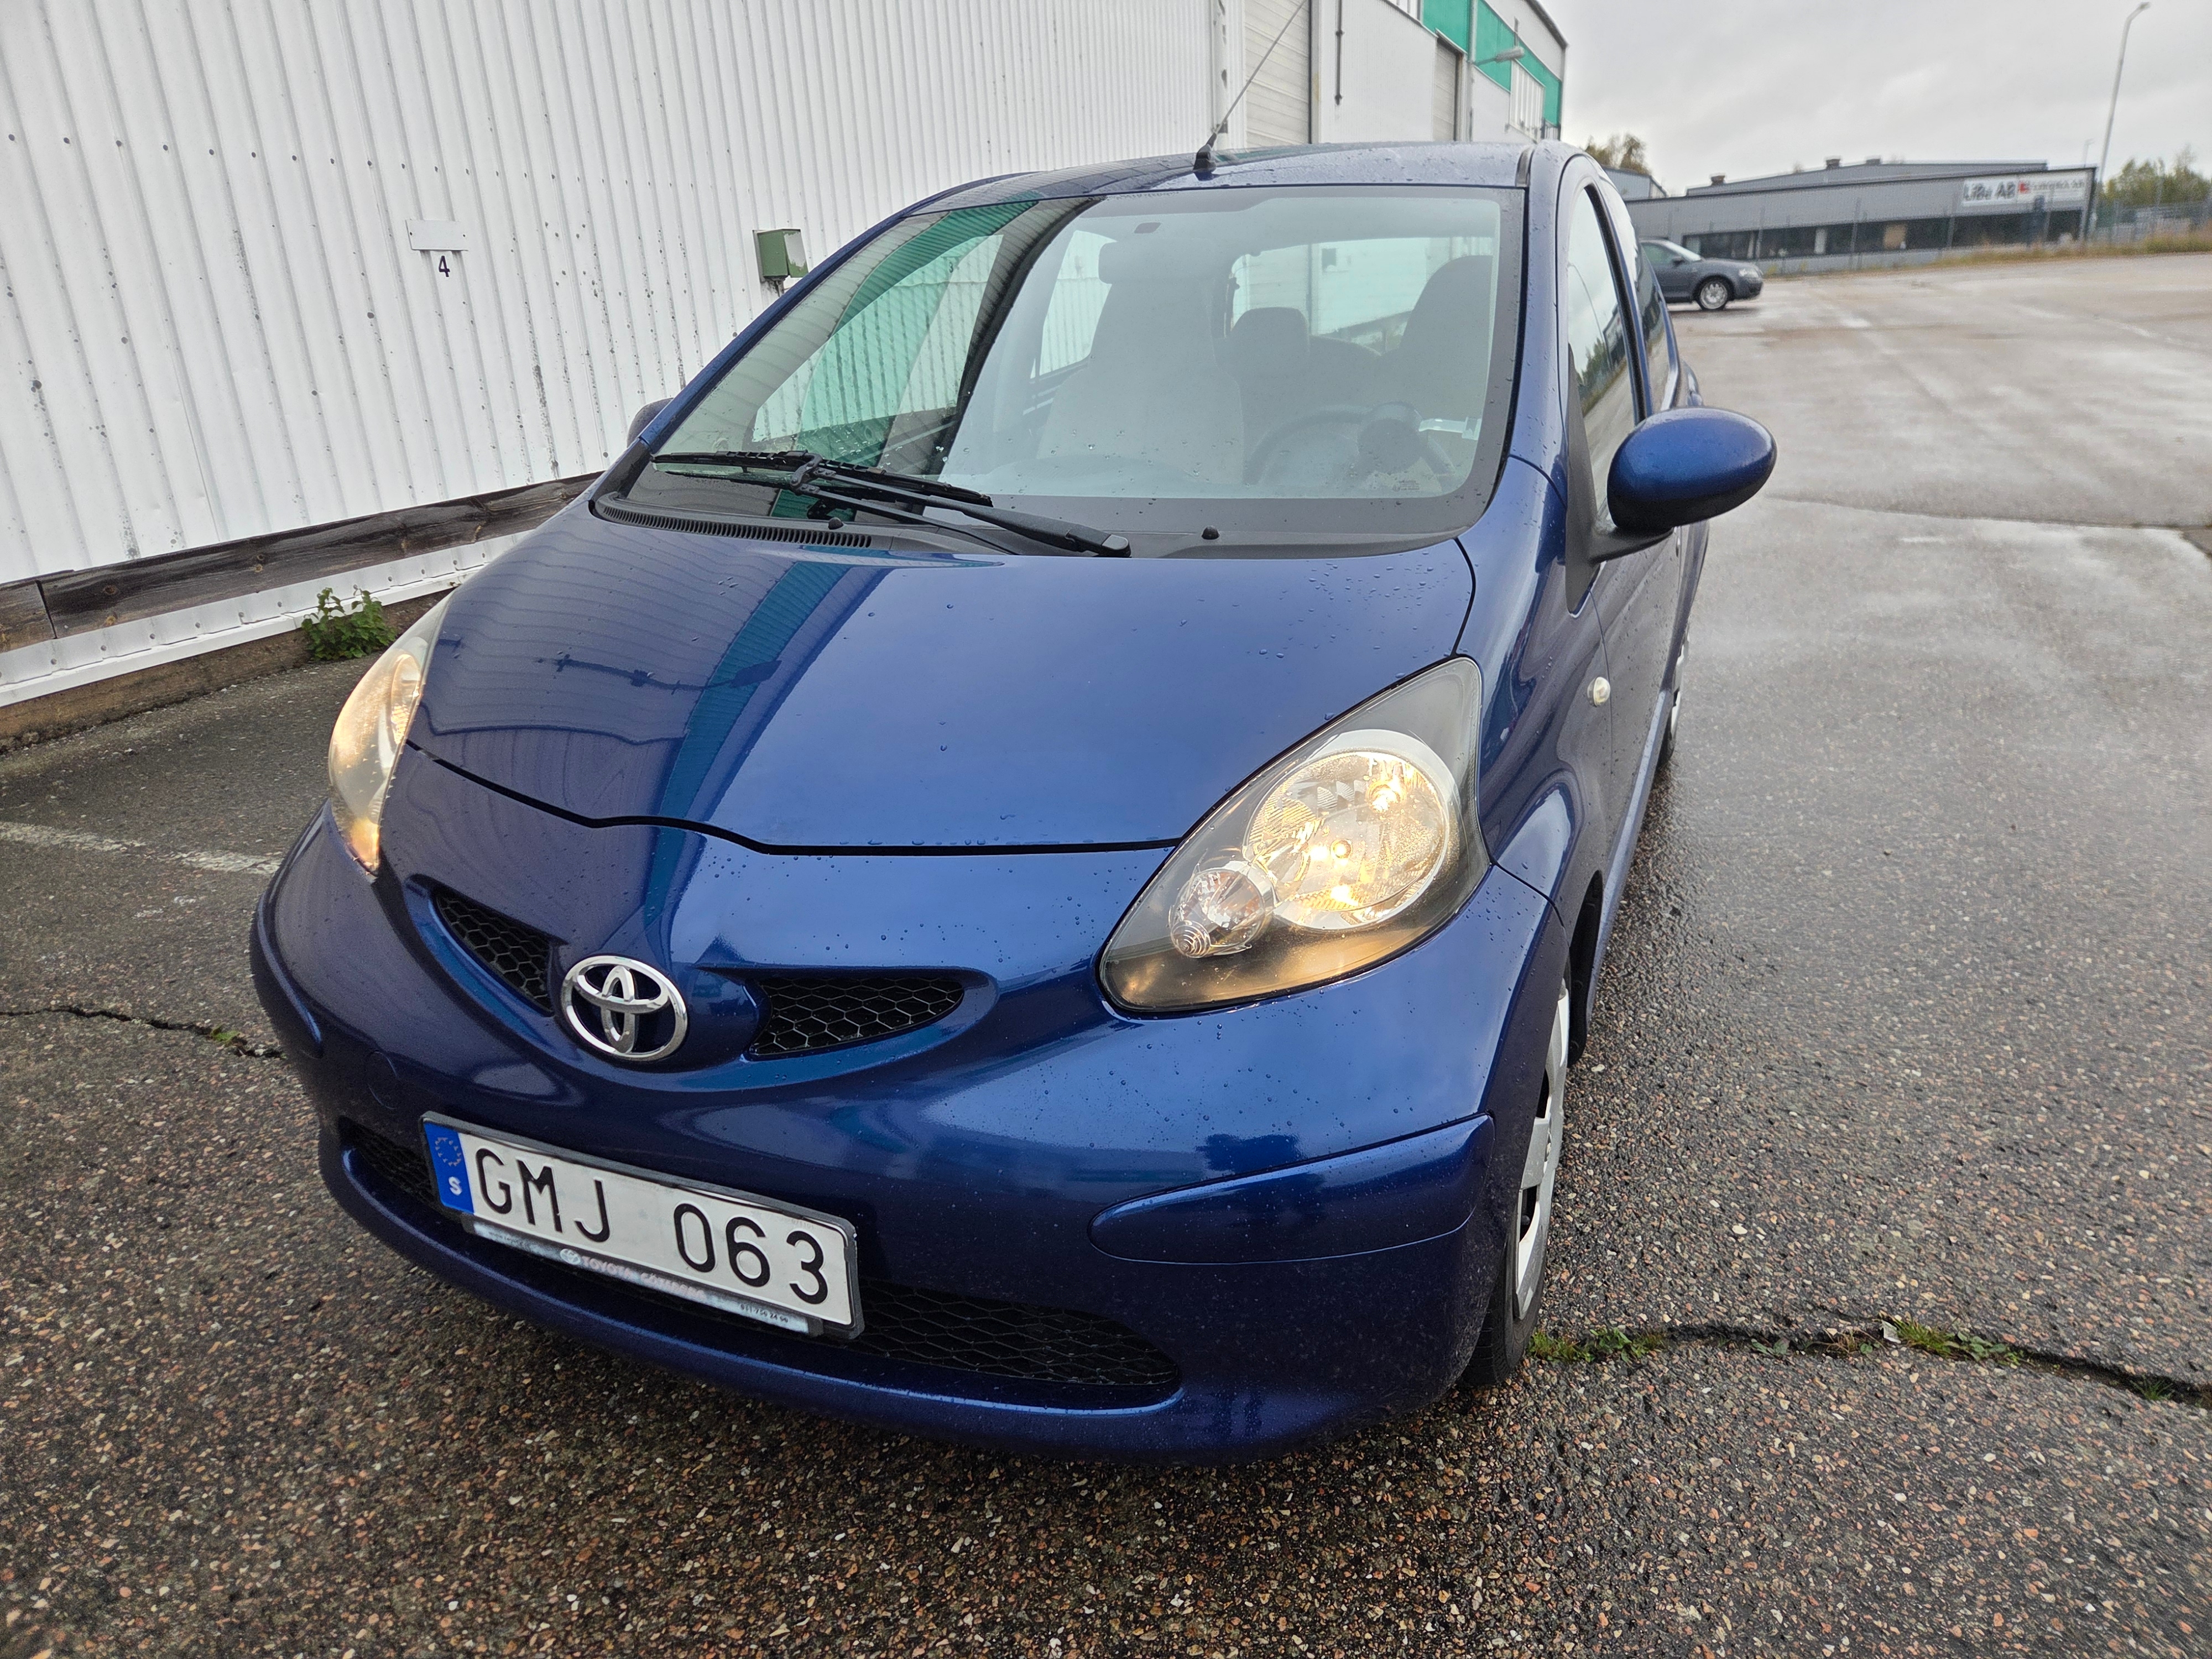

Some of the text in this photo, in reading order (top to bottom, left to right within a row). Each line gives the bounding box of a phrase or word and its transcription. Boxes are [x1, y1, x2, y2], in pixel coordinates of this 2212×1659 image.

[439, 255, 450, 277] 4
[948, 261, 954, 273] 3
[449, 1177, 462, 1196] S
[476, 1148, 828, 1305] GMJ 063
[581, 1255, 635, 1280] TOYOTA
